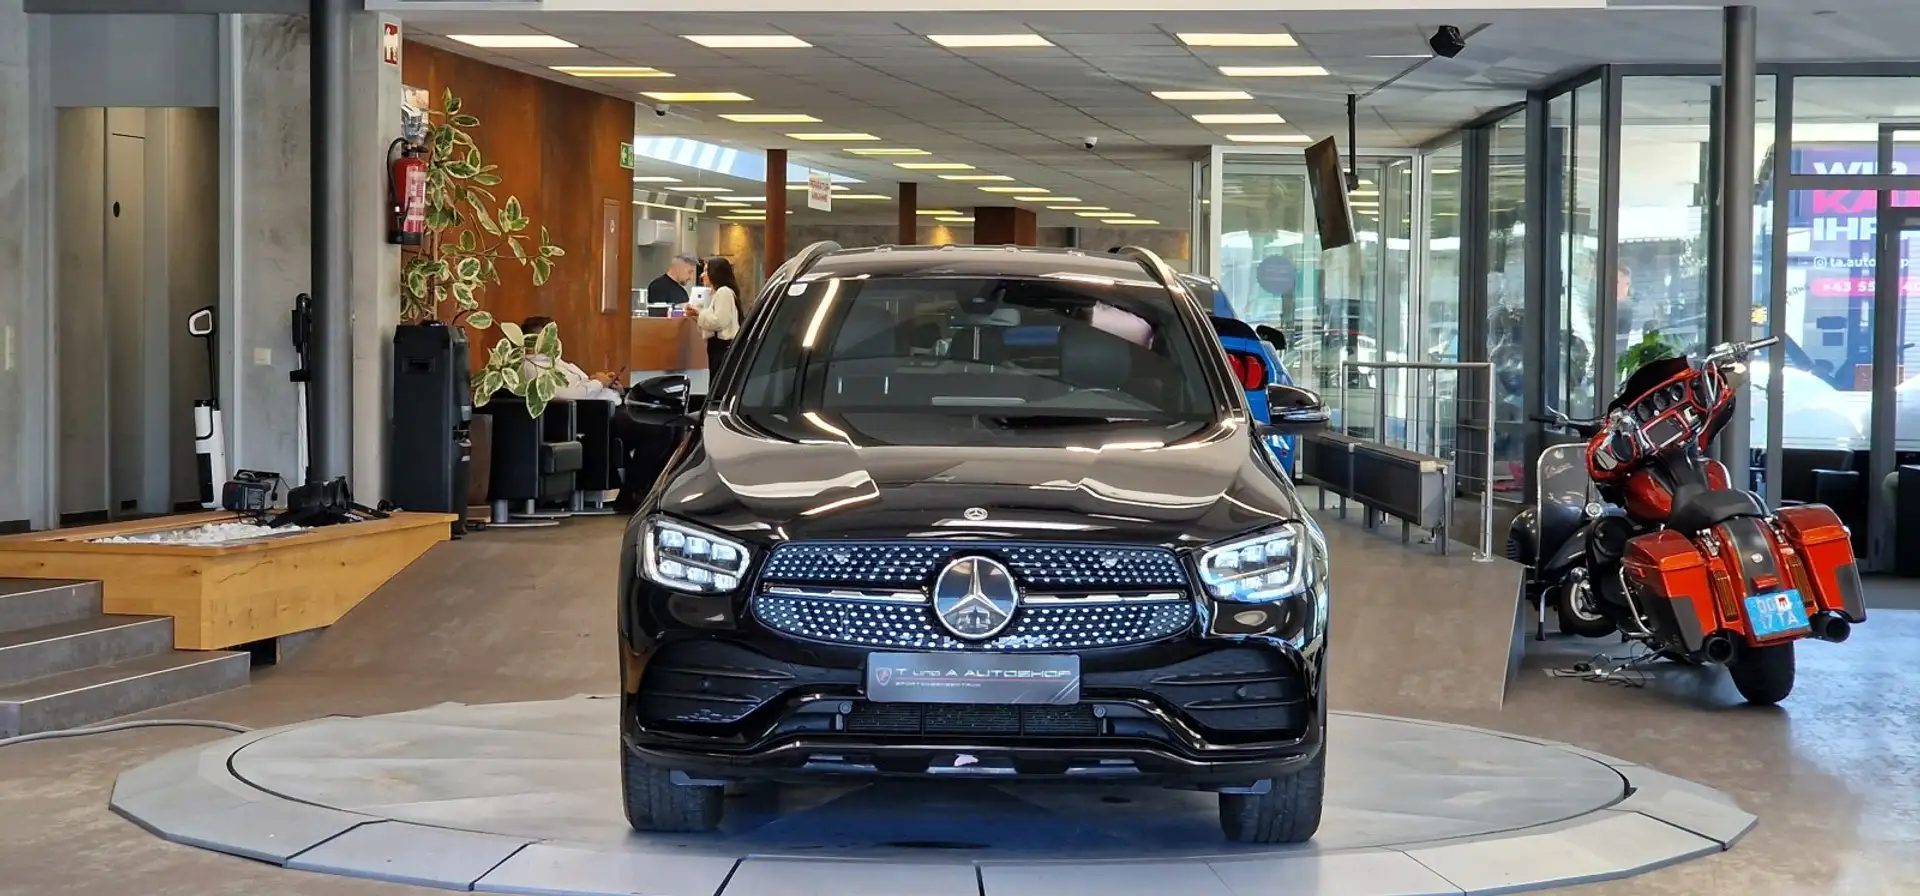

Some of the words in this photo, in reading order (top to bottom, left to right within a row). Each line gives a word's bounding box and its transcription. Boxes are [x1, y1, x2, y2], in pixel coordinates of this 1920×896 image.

[895, 667, 908, 677] T
[945, 669, 958, 678] A
[964, 670, 1072, 679] AUTOSHOP
